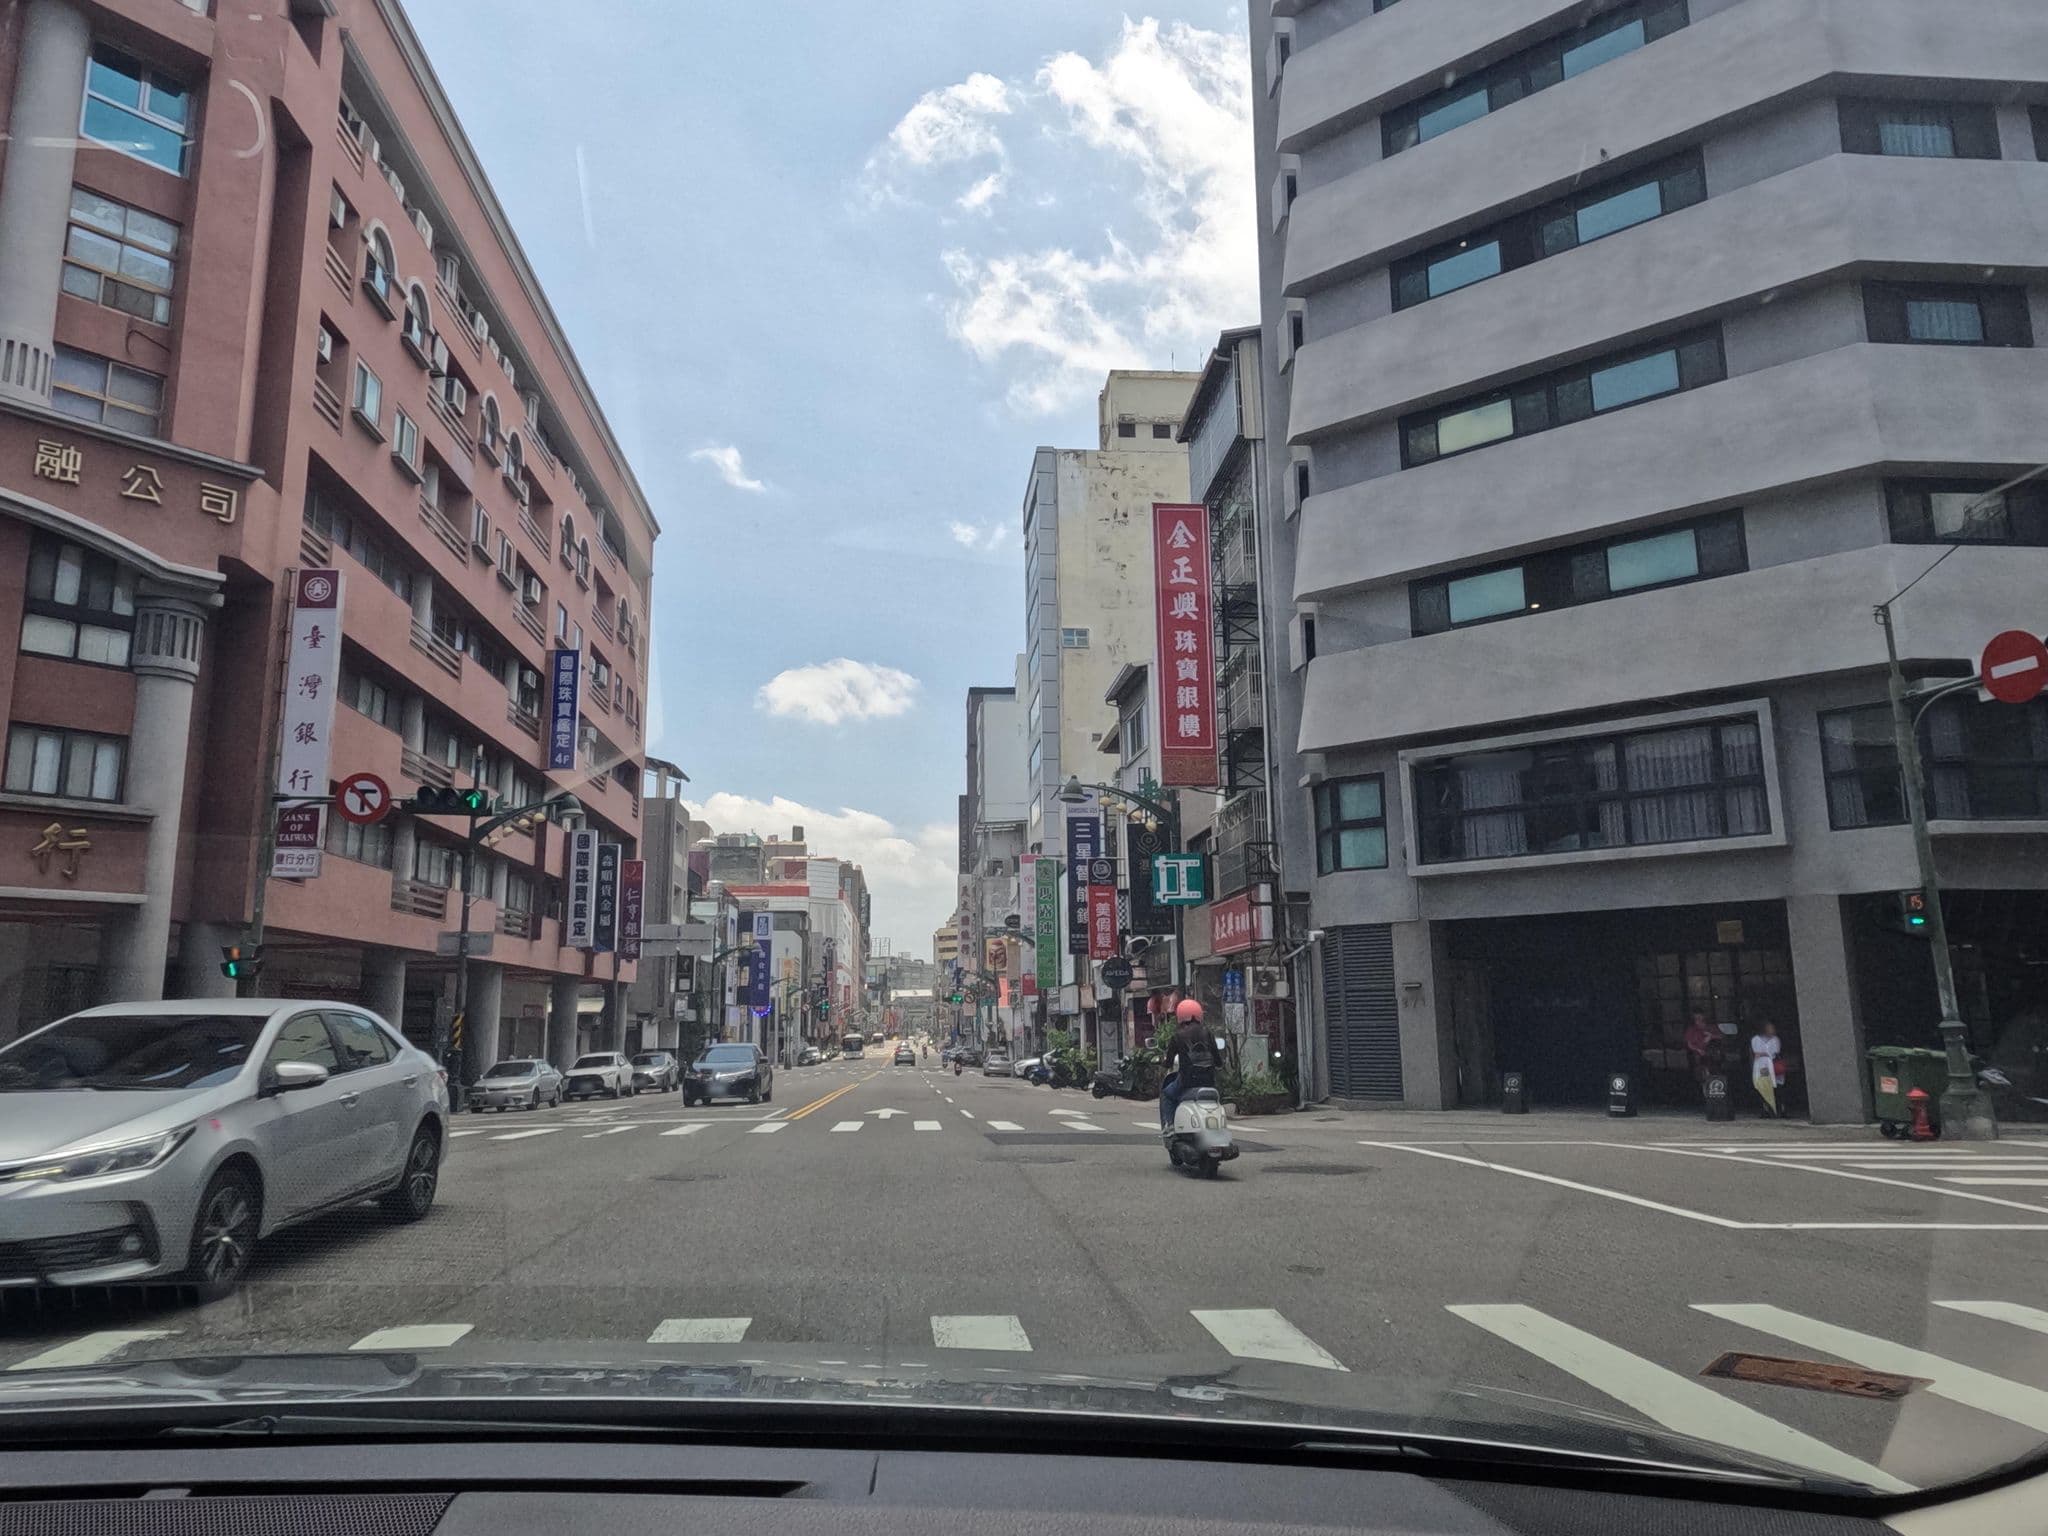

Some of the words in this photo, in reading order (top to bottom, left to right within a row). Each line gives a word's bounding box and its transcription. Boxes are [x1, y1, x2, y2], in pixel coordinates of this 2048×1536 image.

[34, 439, 238, 524] 融公司
[1167, 520, 1200, 738] 金正興珠寶銀樓
[288, 625, 326, 792] 臺灣銀行
[556, 655, 574, 748] 國際珠寶鑑定
[555, 753, 570, 765] 4F
[31, 822, 91, 880] 行
[279, 833, 314, 842] TAIWAN
[289, 824, 304, 832] OF
[573, 834, 590, 937] 國際珠寶鑑定
